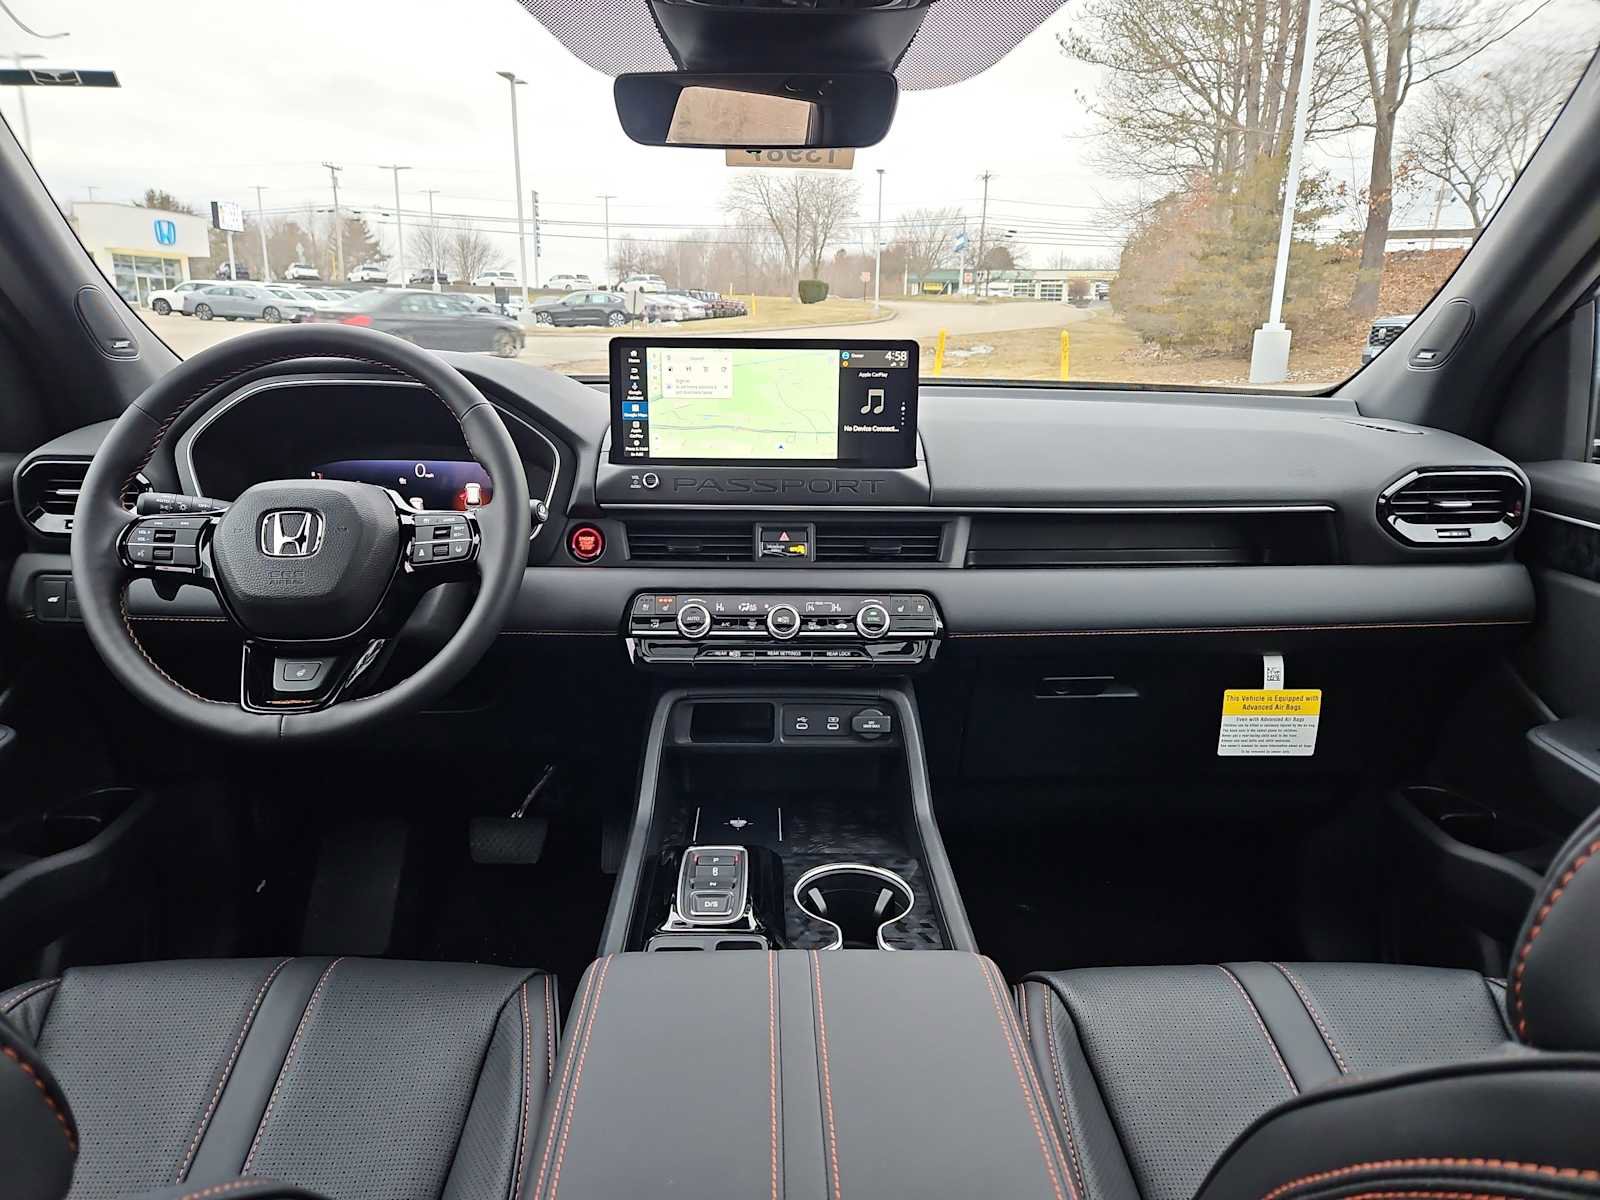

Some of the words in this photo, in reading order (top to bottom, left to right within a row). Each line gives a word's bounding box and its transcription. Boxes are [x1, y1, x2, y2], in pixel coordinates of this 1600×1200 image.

[885, 350, 907, 361] 4:58
[414, 463, 426, 478] 0
[672, 477, 886, 494] PASSPORT
[1226, 694, 1240, 702] This
[1241, 694, 1265, 702] Vehicle
[1274, 694, 1304, 703] Equipped
[1305, 694, 1319, 702] with
[1242, 703, 1273, 711] Advanced
[1274, 703, 1284, 711] Air
[1285, 703, 1302, 712] Bags
